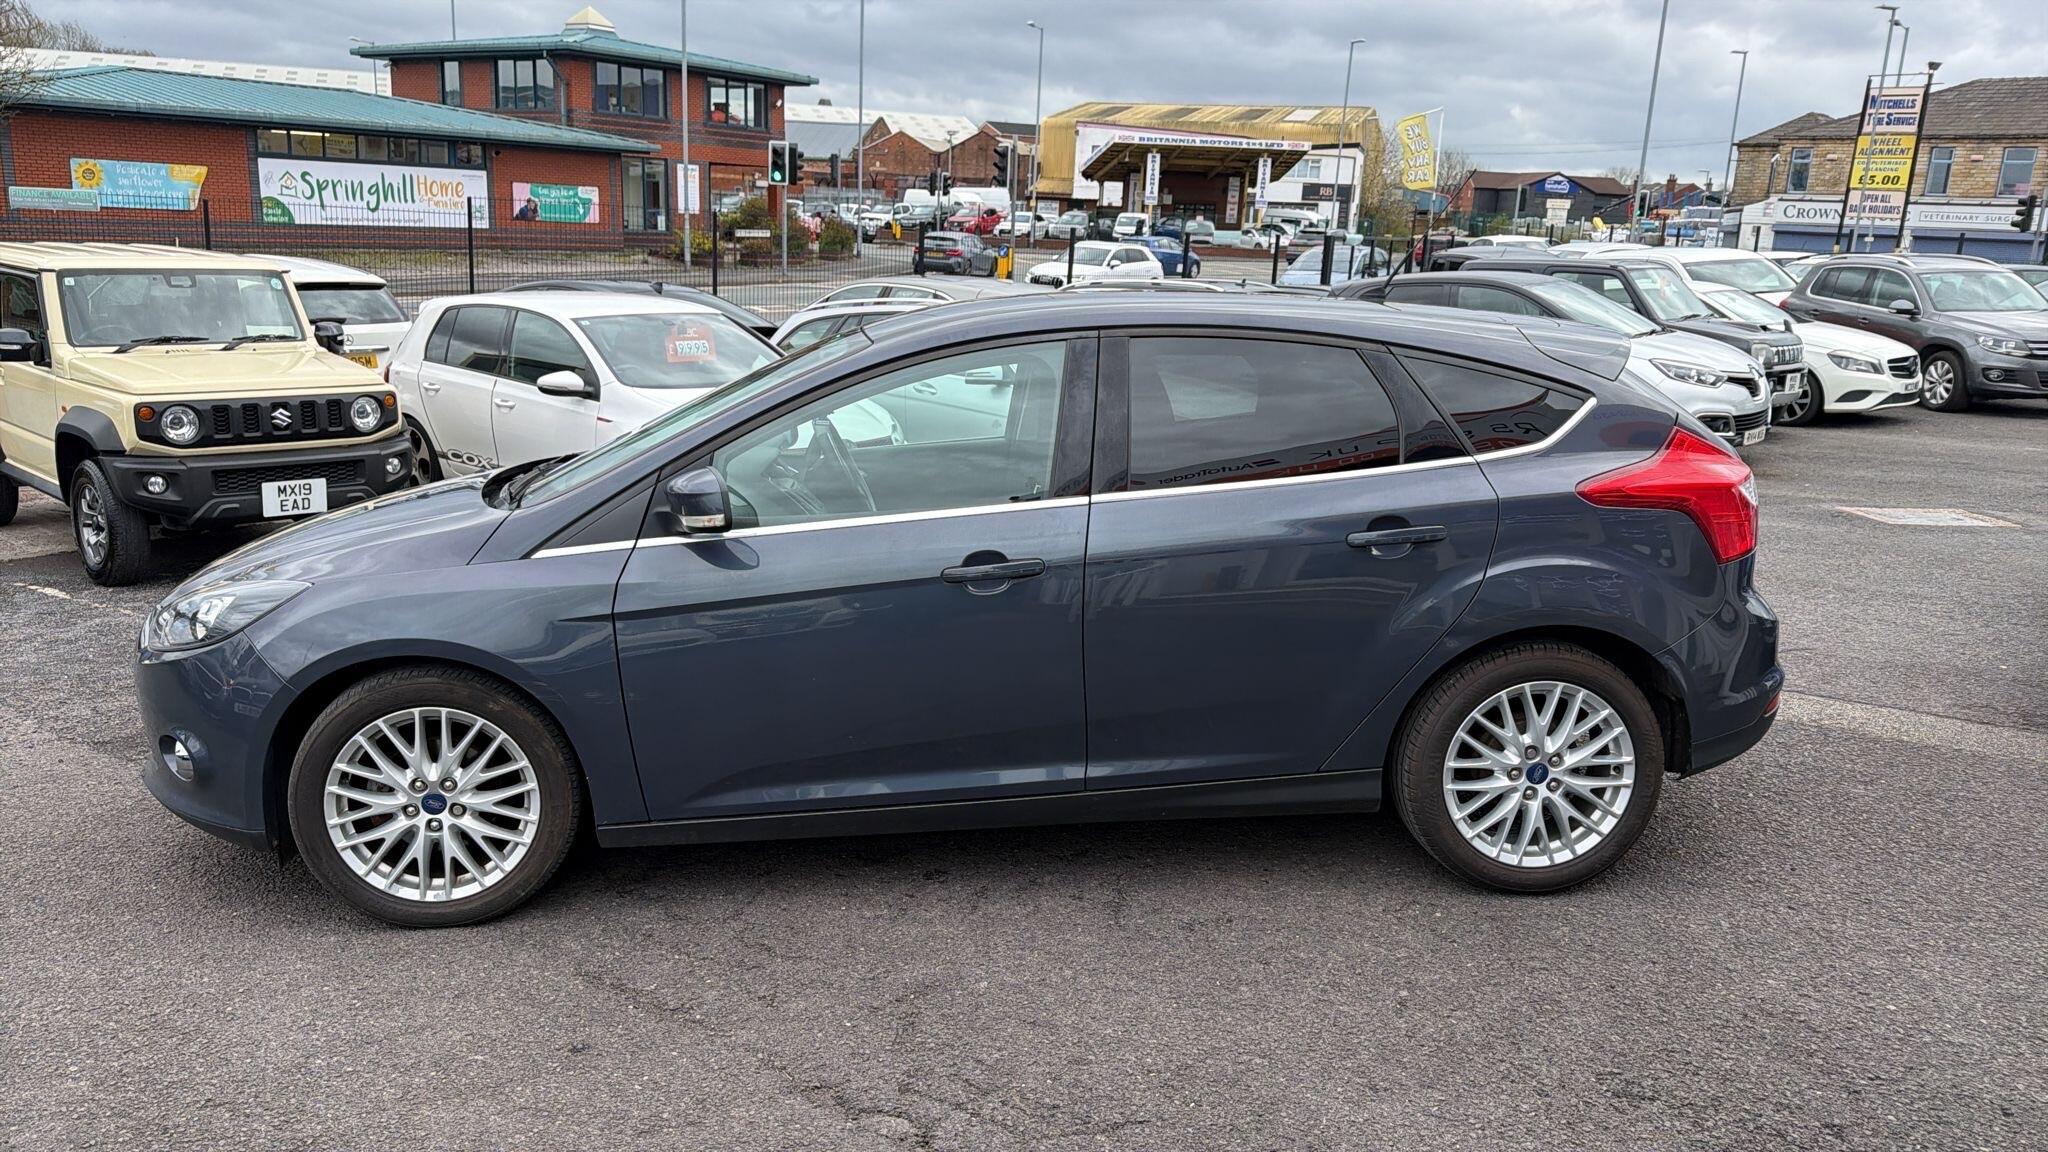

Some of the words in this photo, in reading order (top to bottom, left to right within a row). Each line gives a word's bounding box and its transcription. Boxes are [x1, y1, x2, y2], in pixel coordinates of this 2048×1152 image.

[1869, 95, 1917, 110] MITCHELLS
[1885, 112, 1917, 126] SERVICE
[1138, 136, 1197, 145] BRITANNIA
[1199, 139, 1243, 147] MOTORS
[1858, 147, 1912, 156] ALGNMENT
[1149, 154, 1157, 195] BRITANNIA
[1259, 159, 1268, 199] BRITANNIA
[1858, 174, 1901, 186] £5.00
[11, 189, 49, 198] FINANCE
[50, 191, 95, 200] AVAILABLE
[300, 170, 415, 213] Springhill
[416, 174, 465, 198] Home
[1880, 194, 1892, 203] ALL
[1783, 204, 1842, 220] CROWN
[1848, 204, 1867, 214] BAK
[1868, 204, 1901, 215] HOLIDAYS
[1924, 213, 1980, 222] VETERINARY
[677, 342, 708, 354] 9995
[277, 482, 312, 498] MX19
[280, 497, 311, 512] EAD
